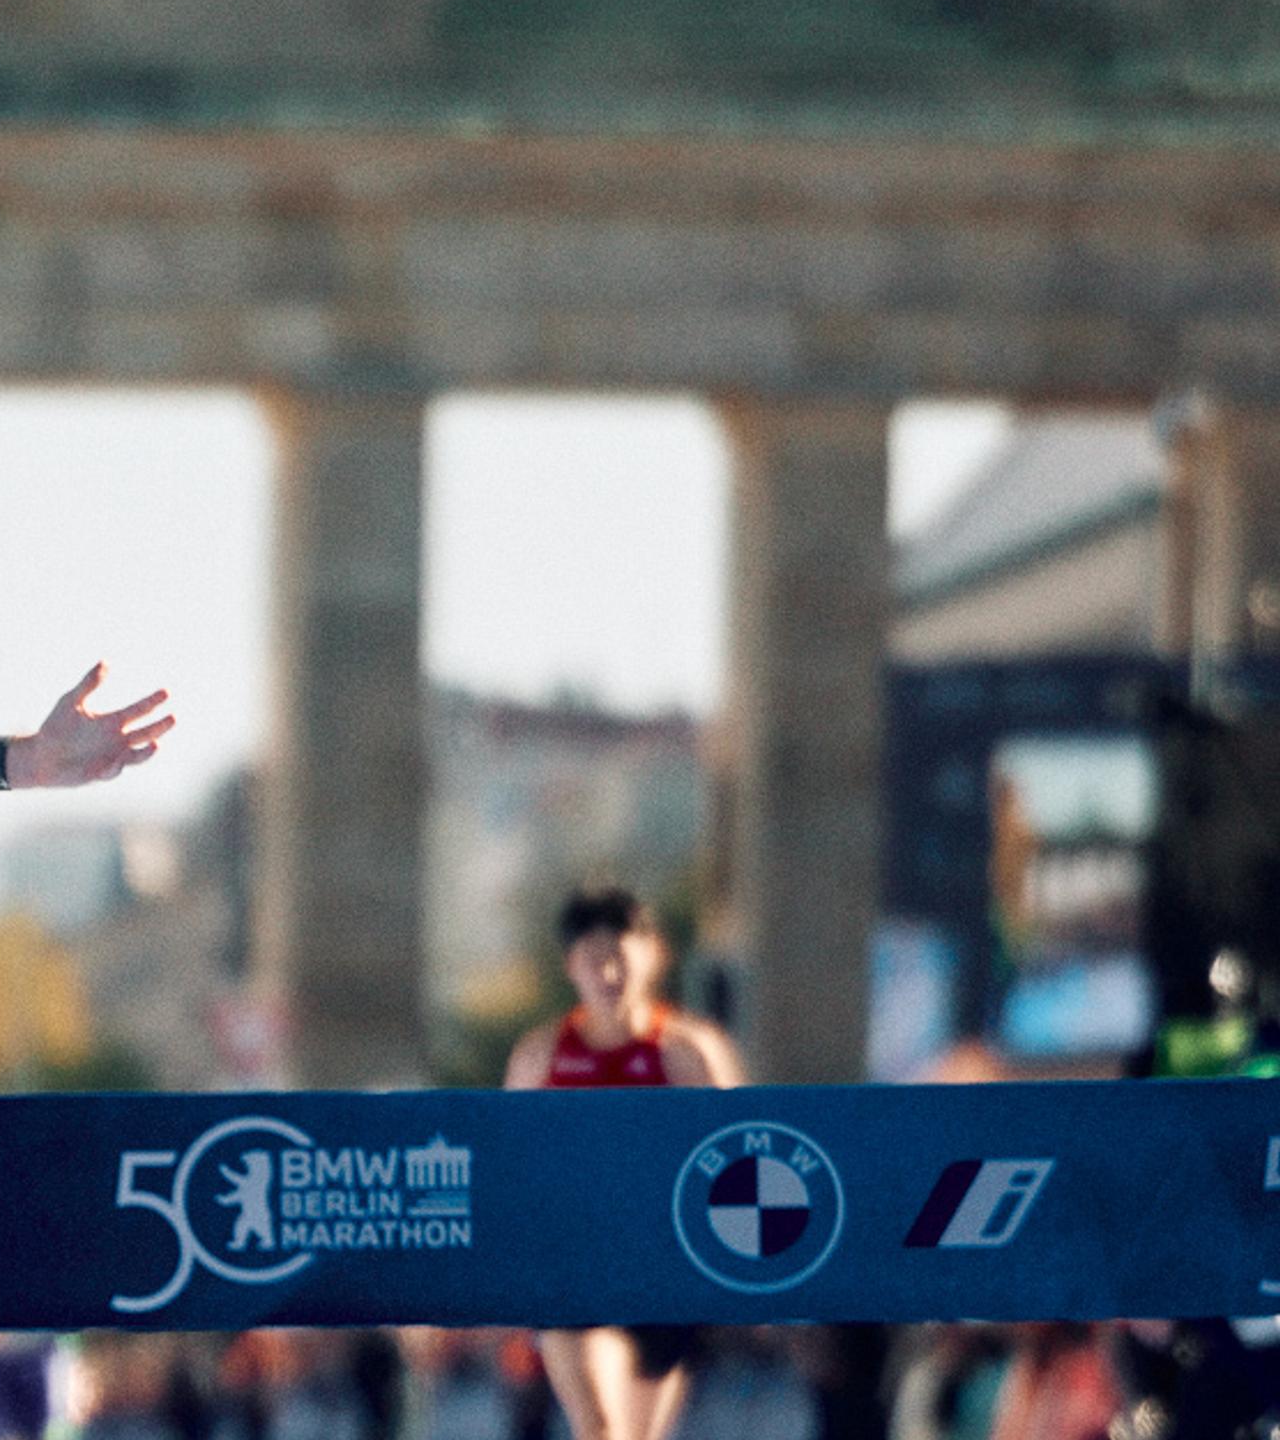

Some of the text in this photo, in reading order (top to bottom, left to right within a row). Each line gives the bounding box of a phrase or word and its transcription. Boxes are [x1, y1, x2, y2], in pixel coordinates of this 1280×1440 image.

[280, 1148, 399, 1188] BMW
[696, 1130, 819, 1177] BMW
[110, 1115, 315, 1313] 50
[280, 1191, 401, 1217] BERLIN
[280, 1221, 472, 1248] MARATHON
